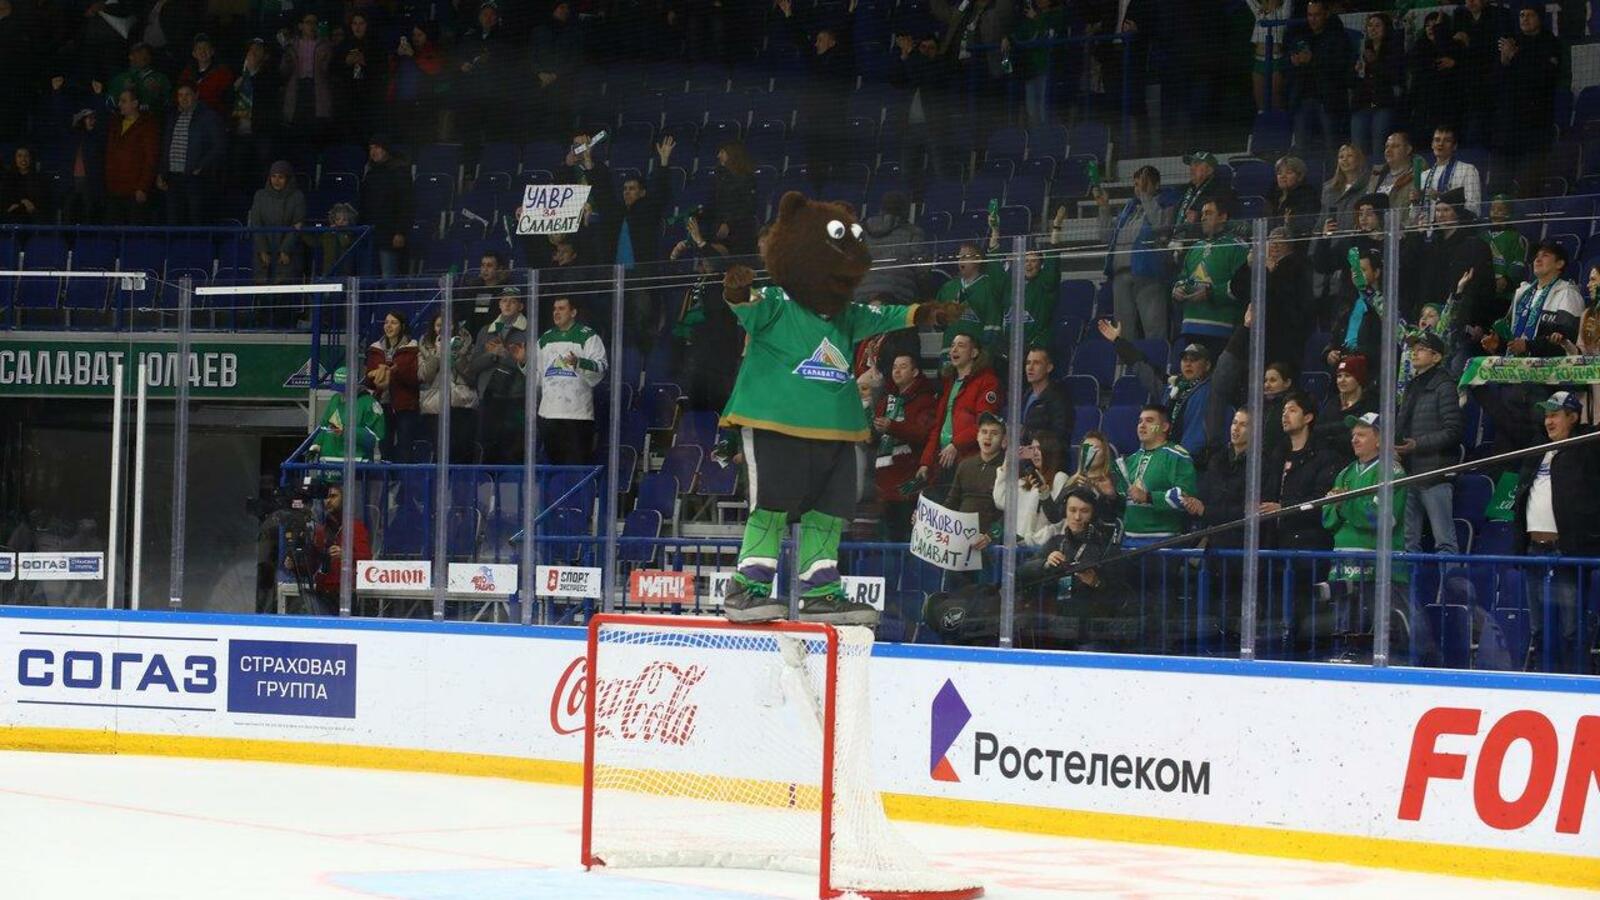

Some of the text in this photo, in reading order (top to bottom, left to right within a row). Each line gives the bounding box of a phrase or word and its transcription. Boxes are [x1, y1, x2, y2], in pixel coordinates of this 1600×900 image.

[526, 187, 574, 209] УАВР
[0, 350, 238, 387] САЛАВАТ ЮЛАЕВ
[936, 531, 950, 546] ЗА
[22, 560, 67, 570] СОГАЗ
[364, 566, 426, 585] Canon
[560, 571, 589, 583] СПОРТ
[638, 575, 686, 599] МАТЧ!
[18, 649, 217, 694] СОГАЗ
[240, 655, 346, 677] СТРАХОВАЯ
[256, 681, 328, 700] ГРУППА
[974, 731, 1211, 796] Ростелеком
